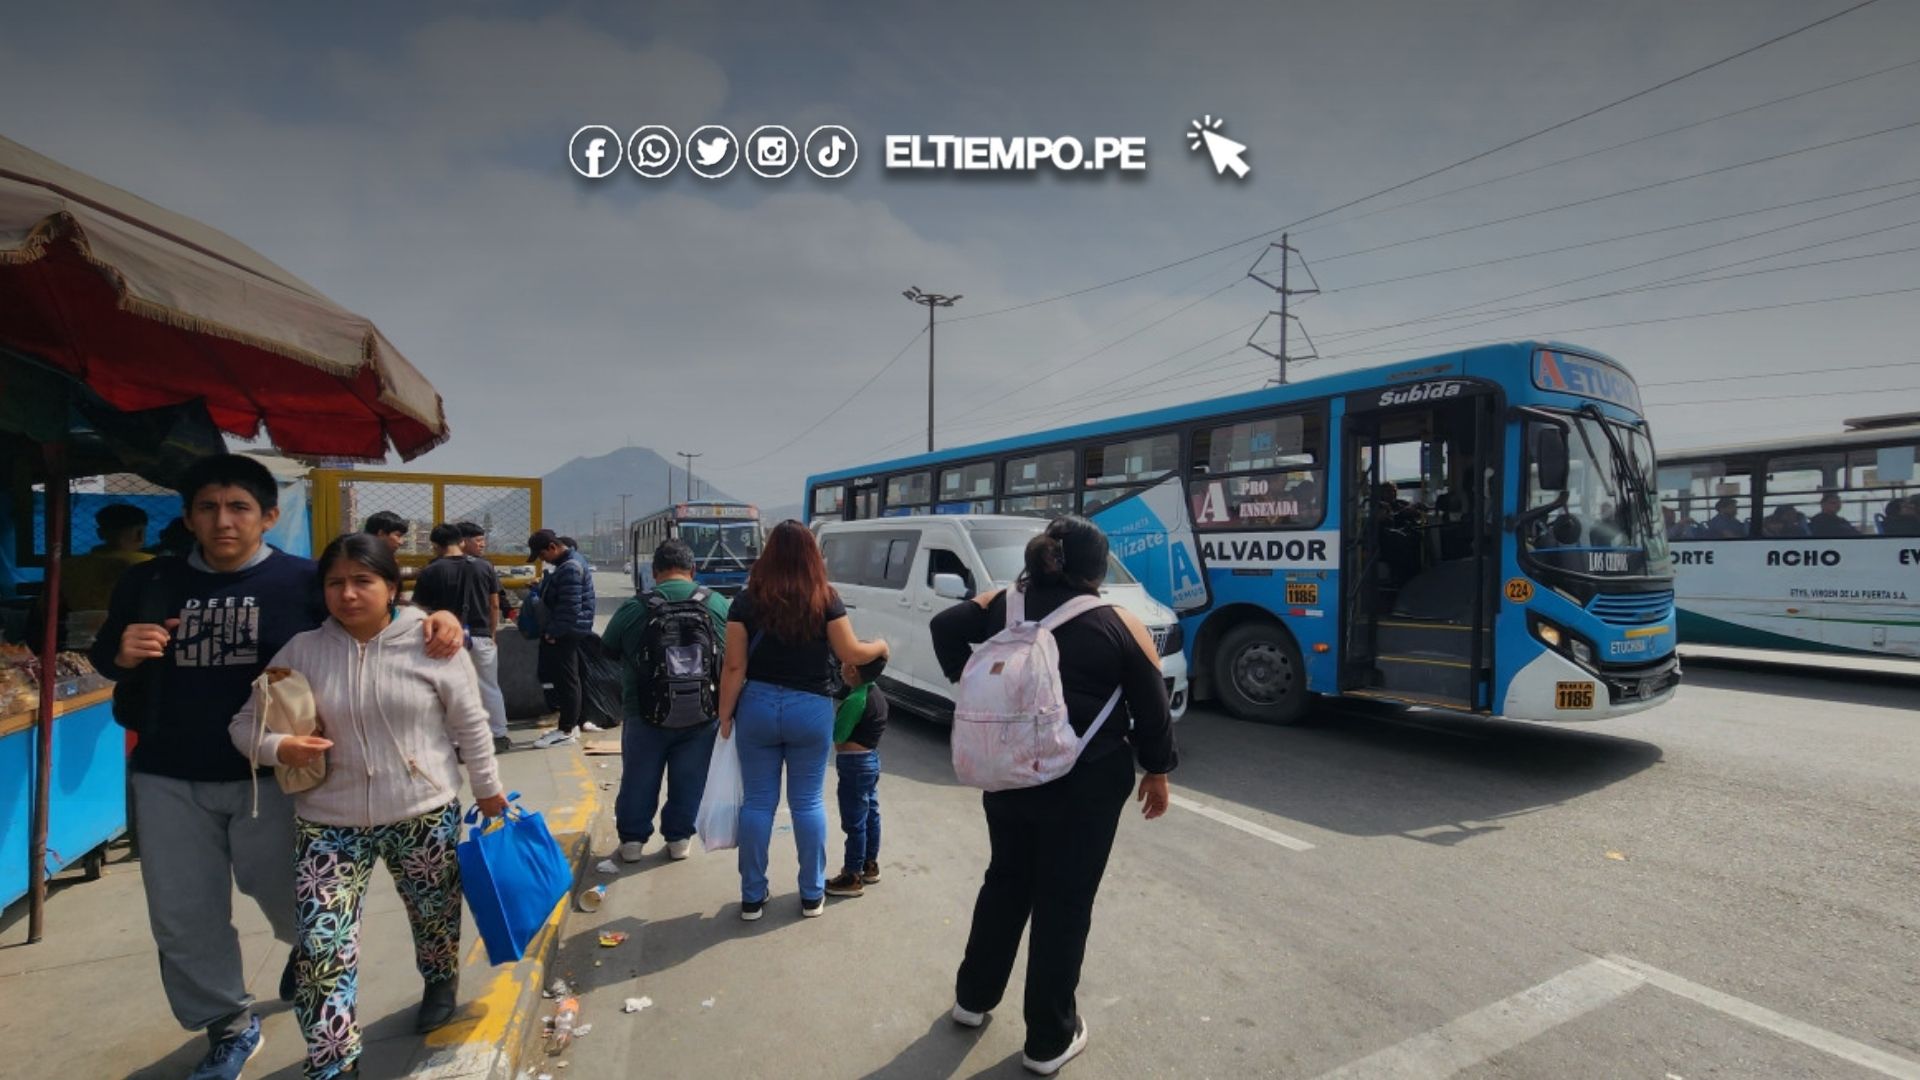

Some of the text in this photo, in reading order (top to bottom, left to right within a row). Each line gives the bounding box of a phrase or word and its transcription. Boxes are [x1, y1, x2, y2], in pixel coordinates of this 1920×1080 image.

[1378, 381, 1462, 406] Subida
[1239, 480, 1269, 496] PRO
[1197, 482, 1230, 523] A
[1239, 501, 1299, 518] ENSENADA
[1767, 550, 1841, 566] ACHO
[1288, 590, 1317, 603] 1185
[1510, 583, 1529, 598] 224
[1811, 588, 1838, 598] VIRGEN
[1850, 590, 1859, 599] LA
[1862, 590, 1891, 600] PUERTA
[1559, 690, 1593, 707] 1185
